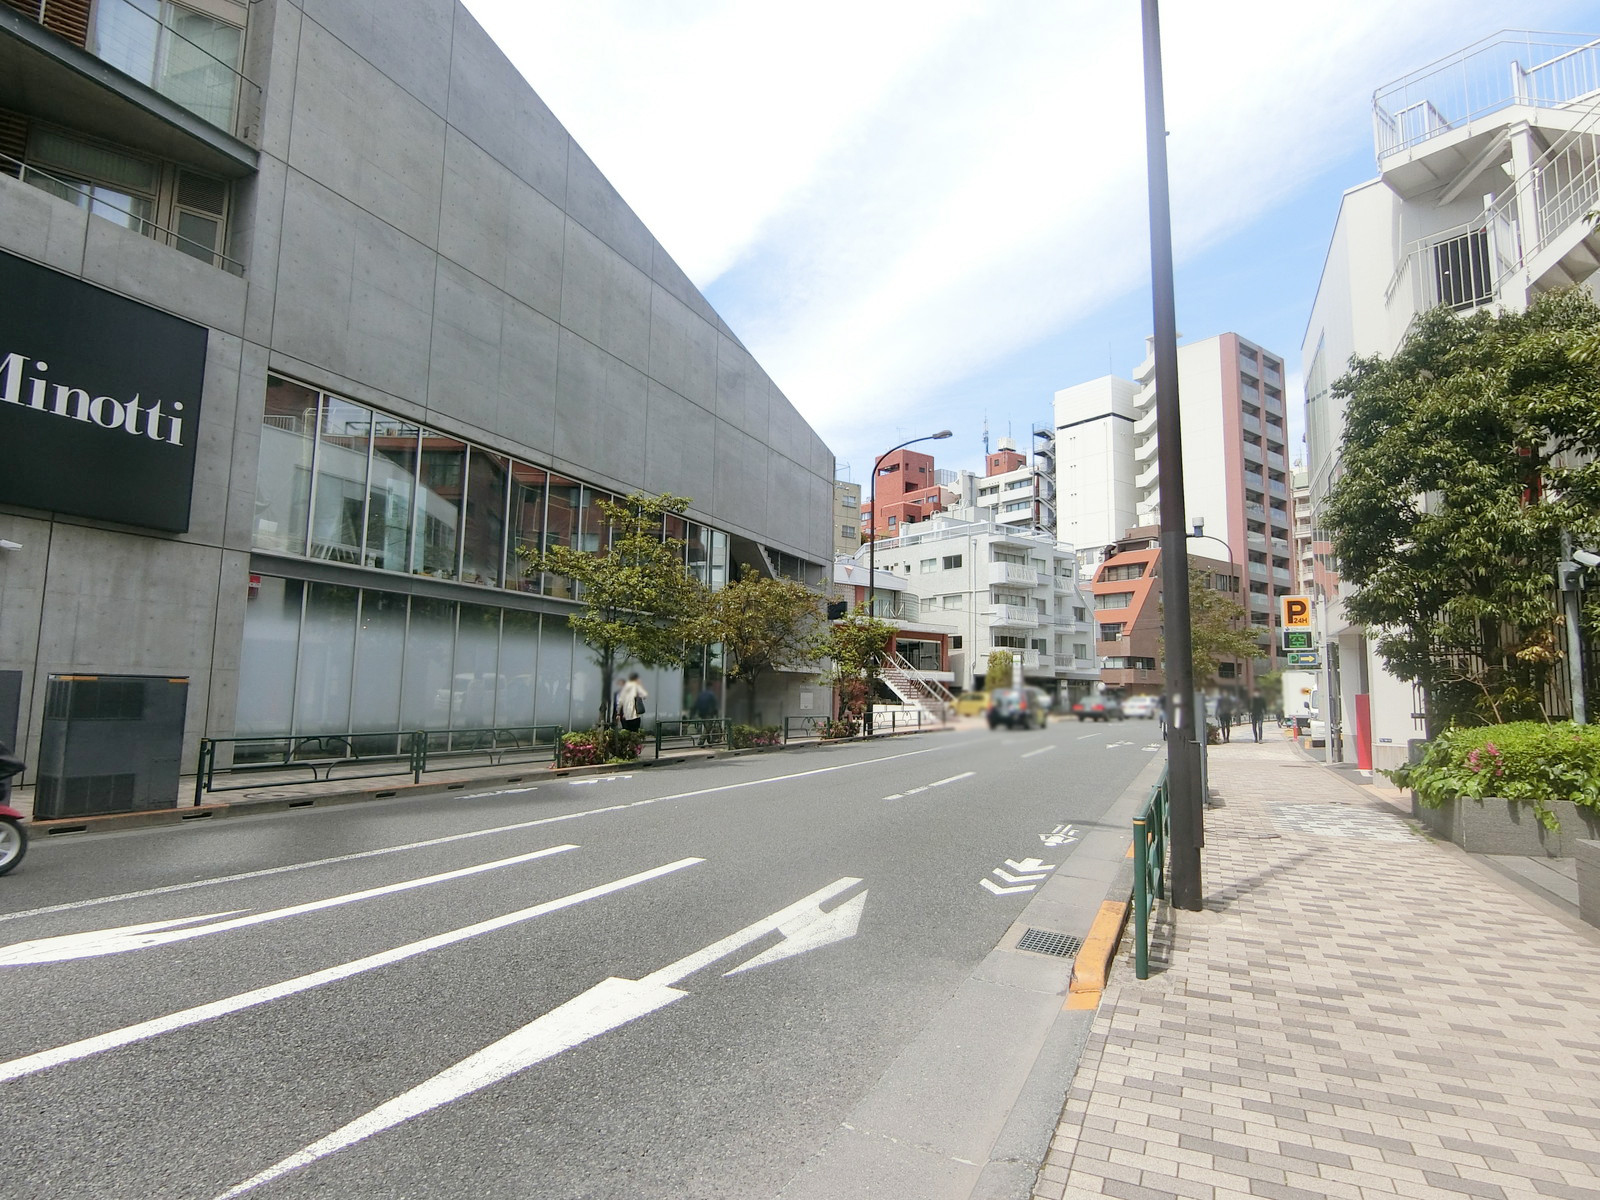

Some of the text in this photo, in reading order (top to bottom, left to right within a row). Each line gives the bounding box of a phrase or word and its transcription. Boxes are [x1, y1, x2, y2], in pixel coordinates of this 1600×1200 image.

[1287, 601, 1306, 623] P
[1289, 632, 1307, 648] 空
[1290, 654, 1298, 664] P
